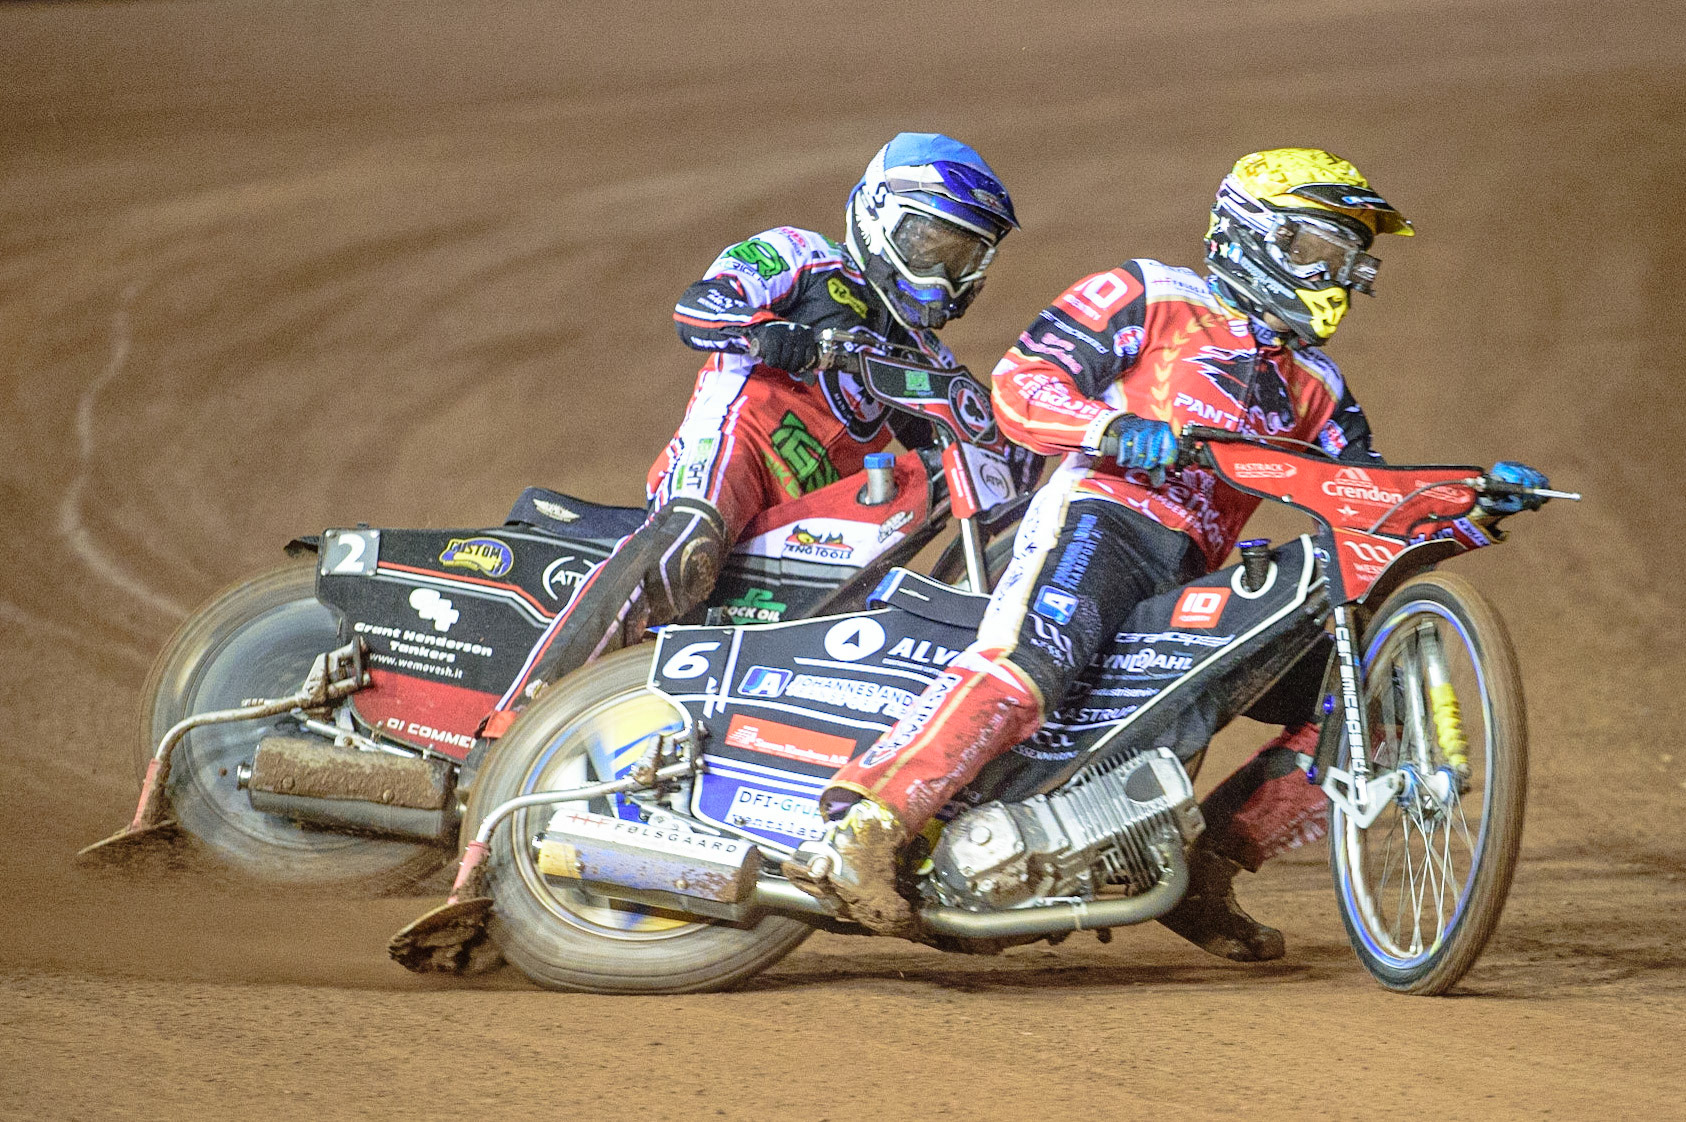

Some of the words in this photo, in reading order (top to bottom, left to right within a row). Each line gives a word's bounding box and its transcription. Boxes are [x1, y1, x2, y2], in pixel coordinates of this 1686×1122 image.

[1174, 392, 1259, 437] PANTH
[1234, 463, 1284, 471] FASTRACK
[1321, 481, 1403, 503] Crendon
[337, 533, 366, 573] 2
[815, 545, 852, 559] TOOLS
[726, 605, 757, 619] OCK
[757, 608, 780, 622] OIL
[354, 621, 401, 639] Grant
[403, 630, 493, 657] Henderson
[390, 640, 456, 663] Tankers
[662, 641, 721, 679] 6
[614, 823, 738, 853] FØLSGAARD
